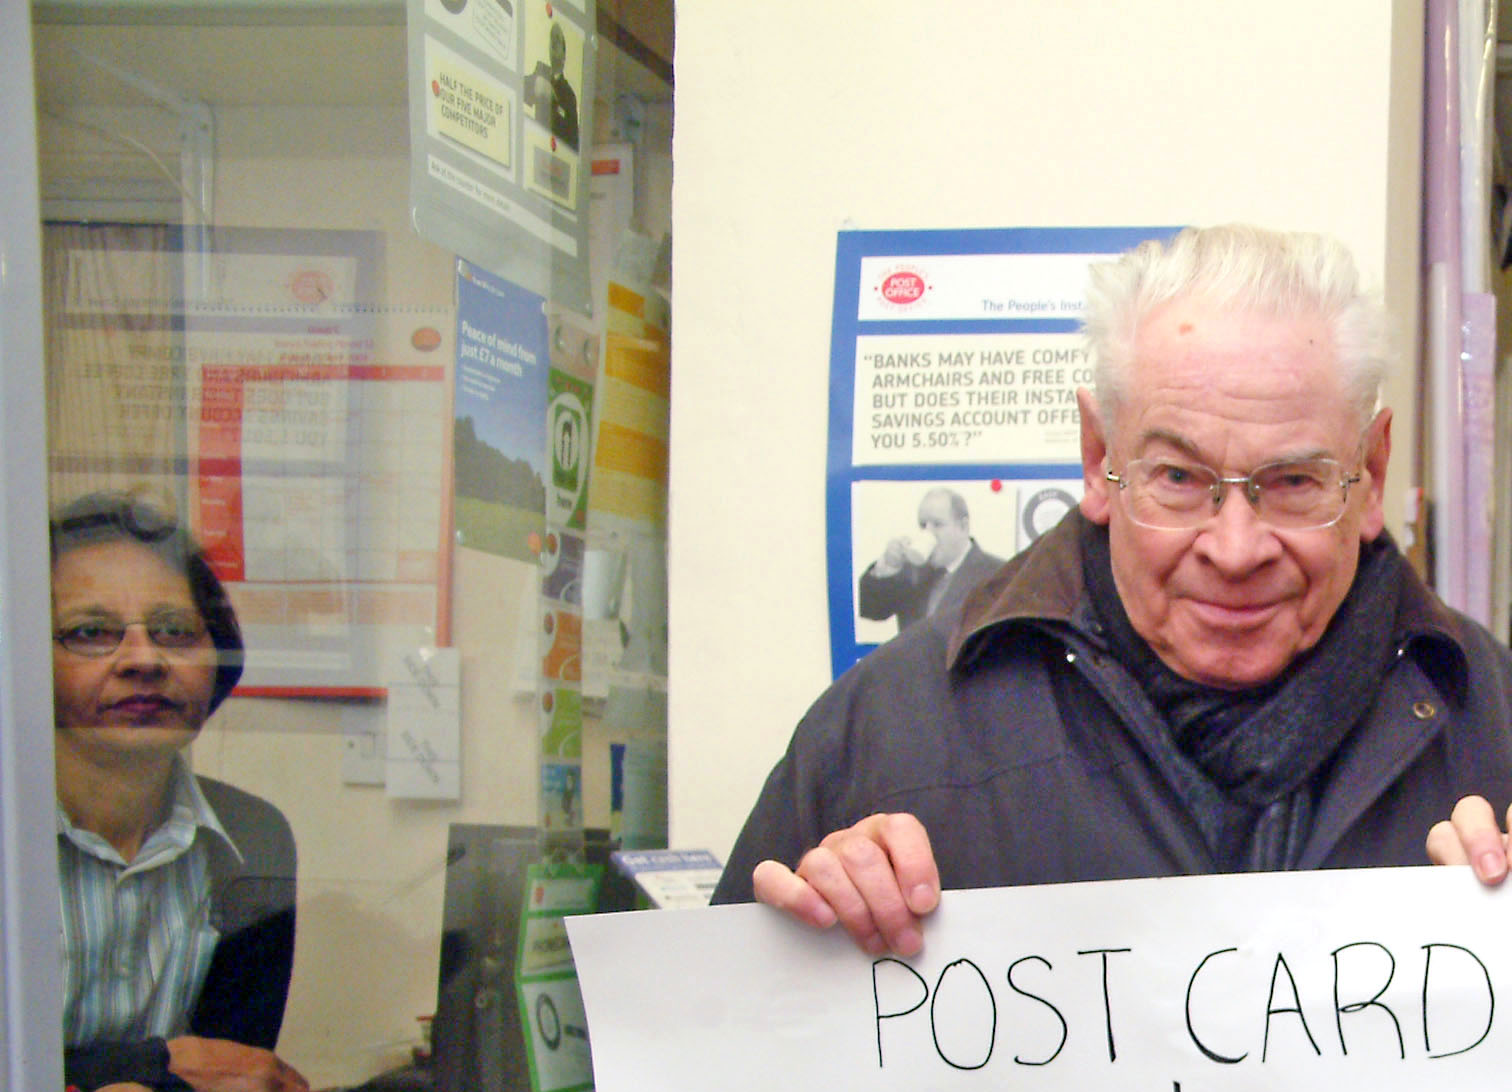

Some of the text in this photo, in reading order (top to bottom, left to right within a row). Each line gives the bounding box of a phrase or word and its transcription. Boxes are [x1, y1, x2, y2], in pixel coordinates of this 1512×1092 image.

[440, 72, 456, 91] HALF
[458, 82, 473, 102] THE
[475, 91, 494, 112] PRICE
[441, 104, 488, 138] COMPETITORS
[457, 97, 473, 115] FIVE
[473, 107, 496, 129] MAJOR
[884, 287, 921, 298] OFFICE
[889, 277, 918, 288] POST
[982, 299, 1085, 313] The People's Inst
[462, 320, 487, 344] Peace
[497, 338, 518, 357] mind
[518, 343, 537, 365] from
[461, 341, 478, 358] just
[496, 357, 523, 377] month
[938, 351, 975, 367] MAY
[980, 350, 1025, 366] HAVE
[1032, 348, 1089, 364] COMFY
[872, 371, 974, 388] ARMCHAIRS
[979, 370, 1016, 385] AND
[1022, 369, 1065, 385] FREE
[872, 388, 1077, 408] BUT DOES THEIR INSTA
[871, 408, 1081, 429] SAVINGS ACCOUNT OFFE
[871, 431, 906, 448] YOU
[872, 942, 1495, 1071] POST CARD
